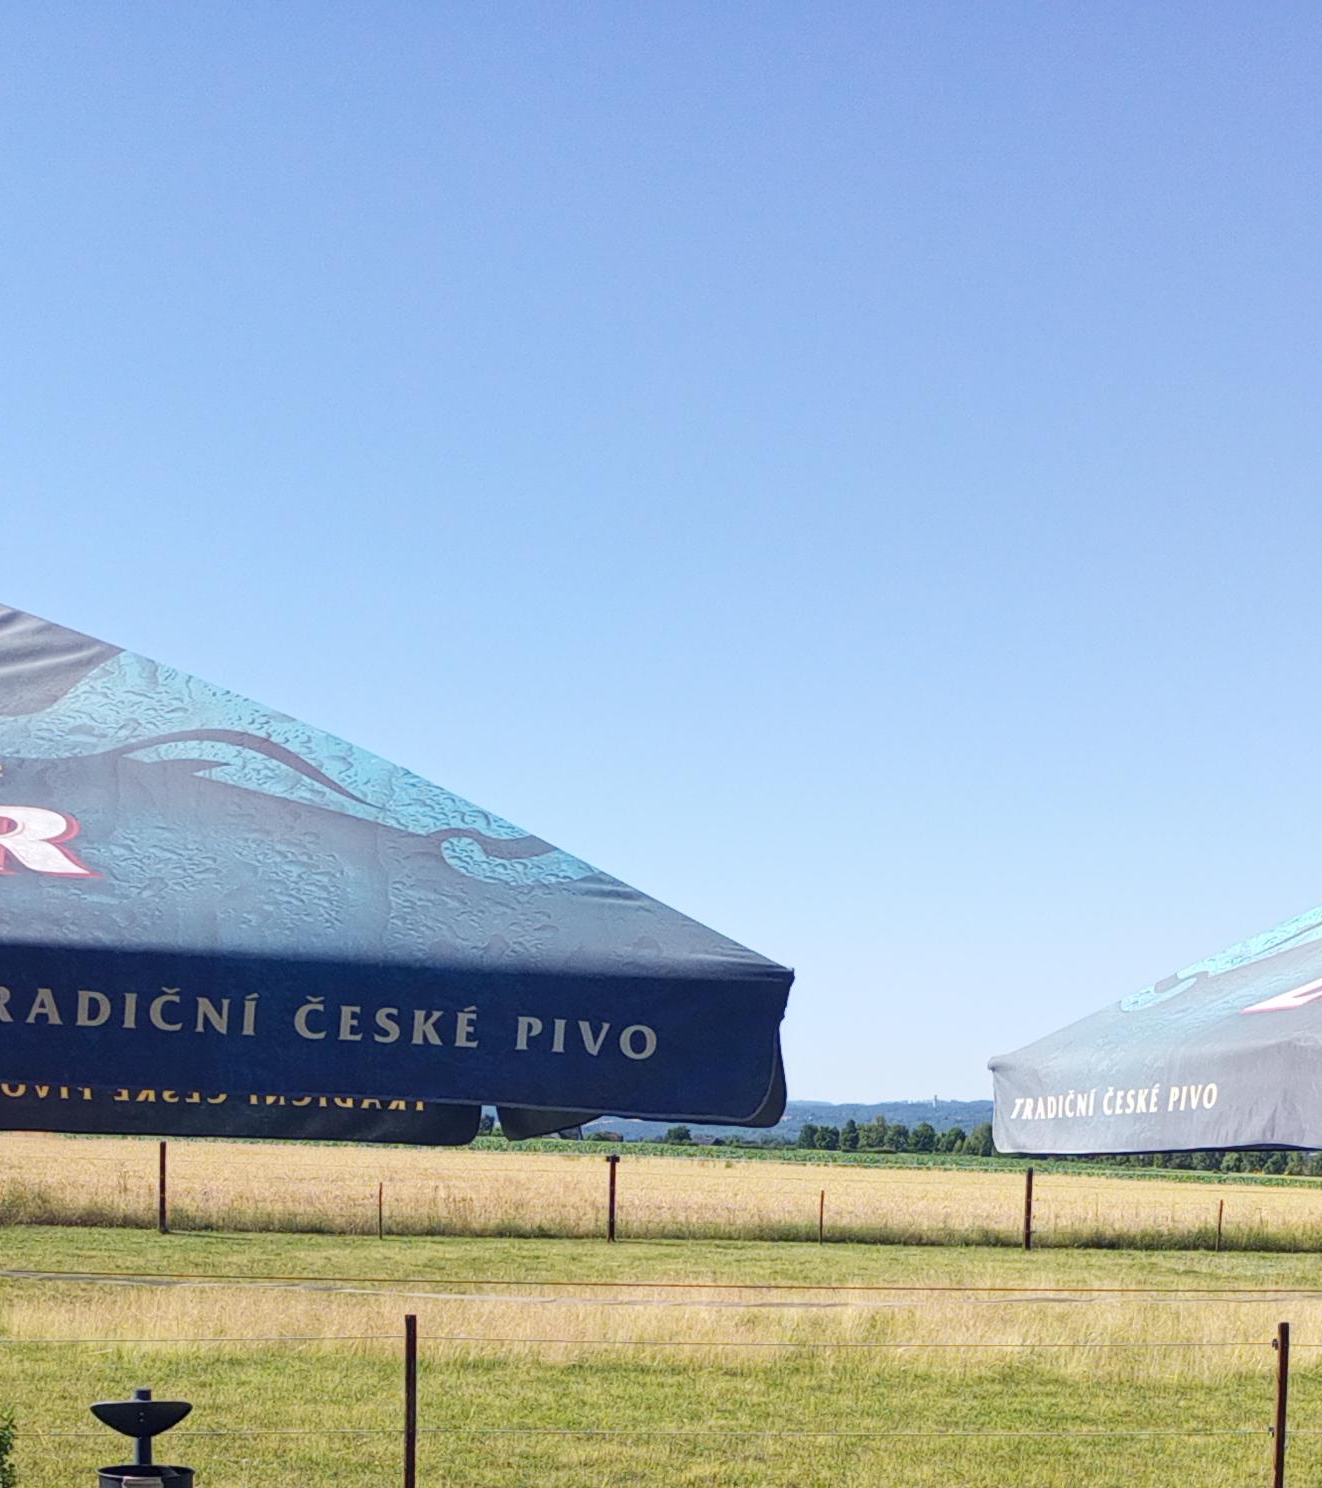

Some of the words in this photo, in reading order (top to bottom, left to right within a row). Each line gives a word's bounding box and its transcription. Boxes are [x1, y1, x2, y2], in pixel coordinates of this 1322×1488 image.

[293, 995, 478, 1048] ČESKÉ
[514, 1016, 658, 1060] PIVO
[1010, 1088, 1097, 1120] TRADIČNÍ
[1102, 1083, 1160, 1116] ČESKÉ
[1167, 1083, 1218, 1111] PIVO
